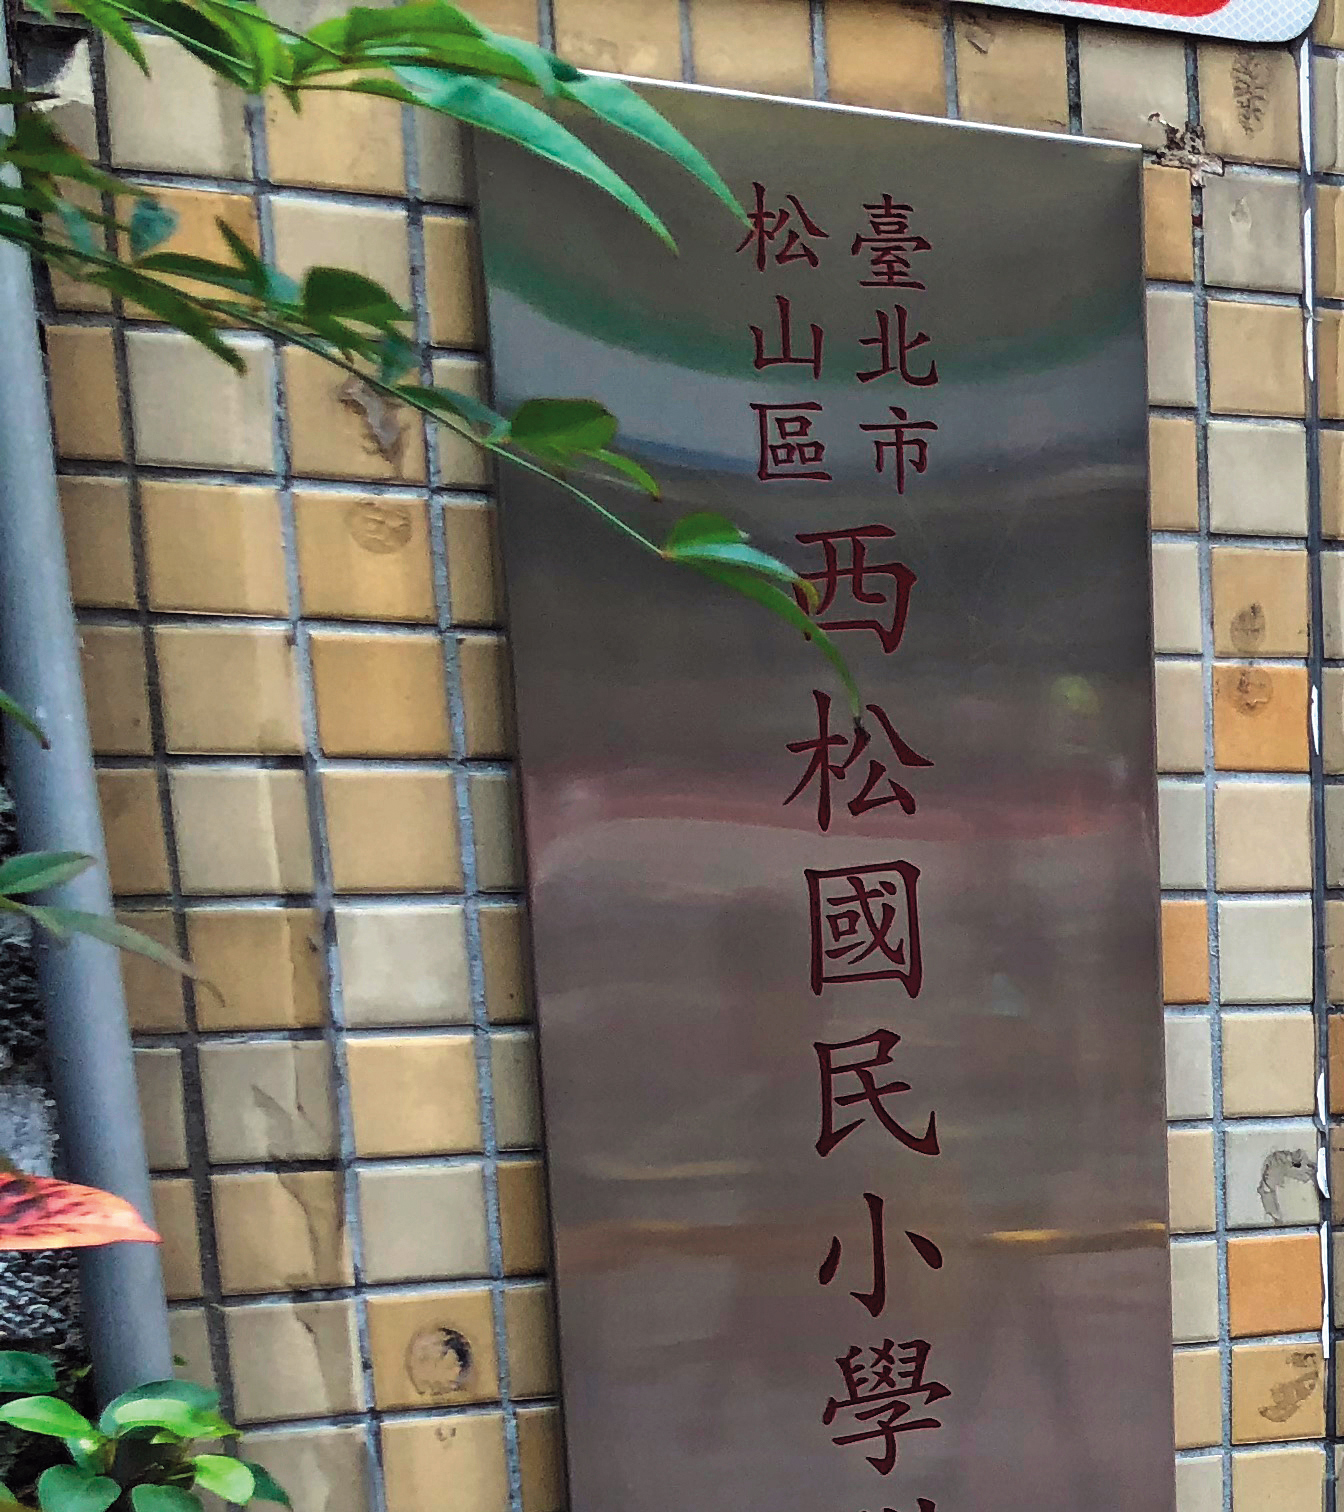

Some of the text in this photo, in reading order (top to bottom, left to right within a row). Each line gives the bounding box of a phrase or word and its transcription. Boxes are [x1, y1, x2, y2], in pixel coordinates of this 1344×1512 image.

[736, 181, 833, 482] 松山區
[850, 193, 940, 496] 臺北市
